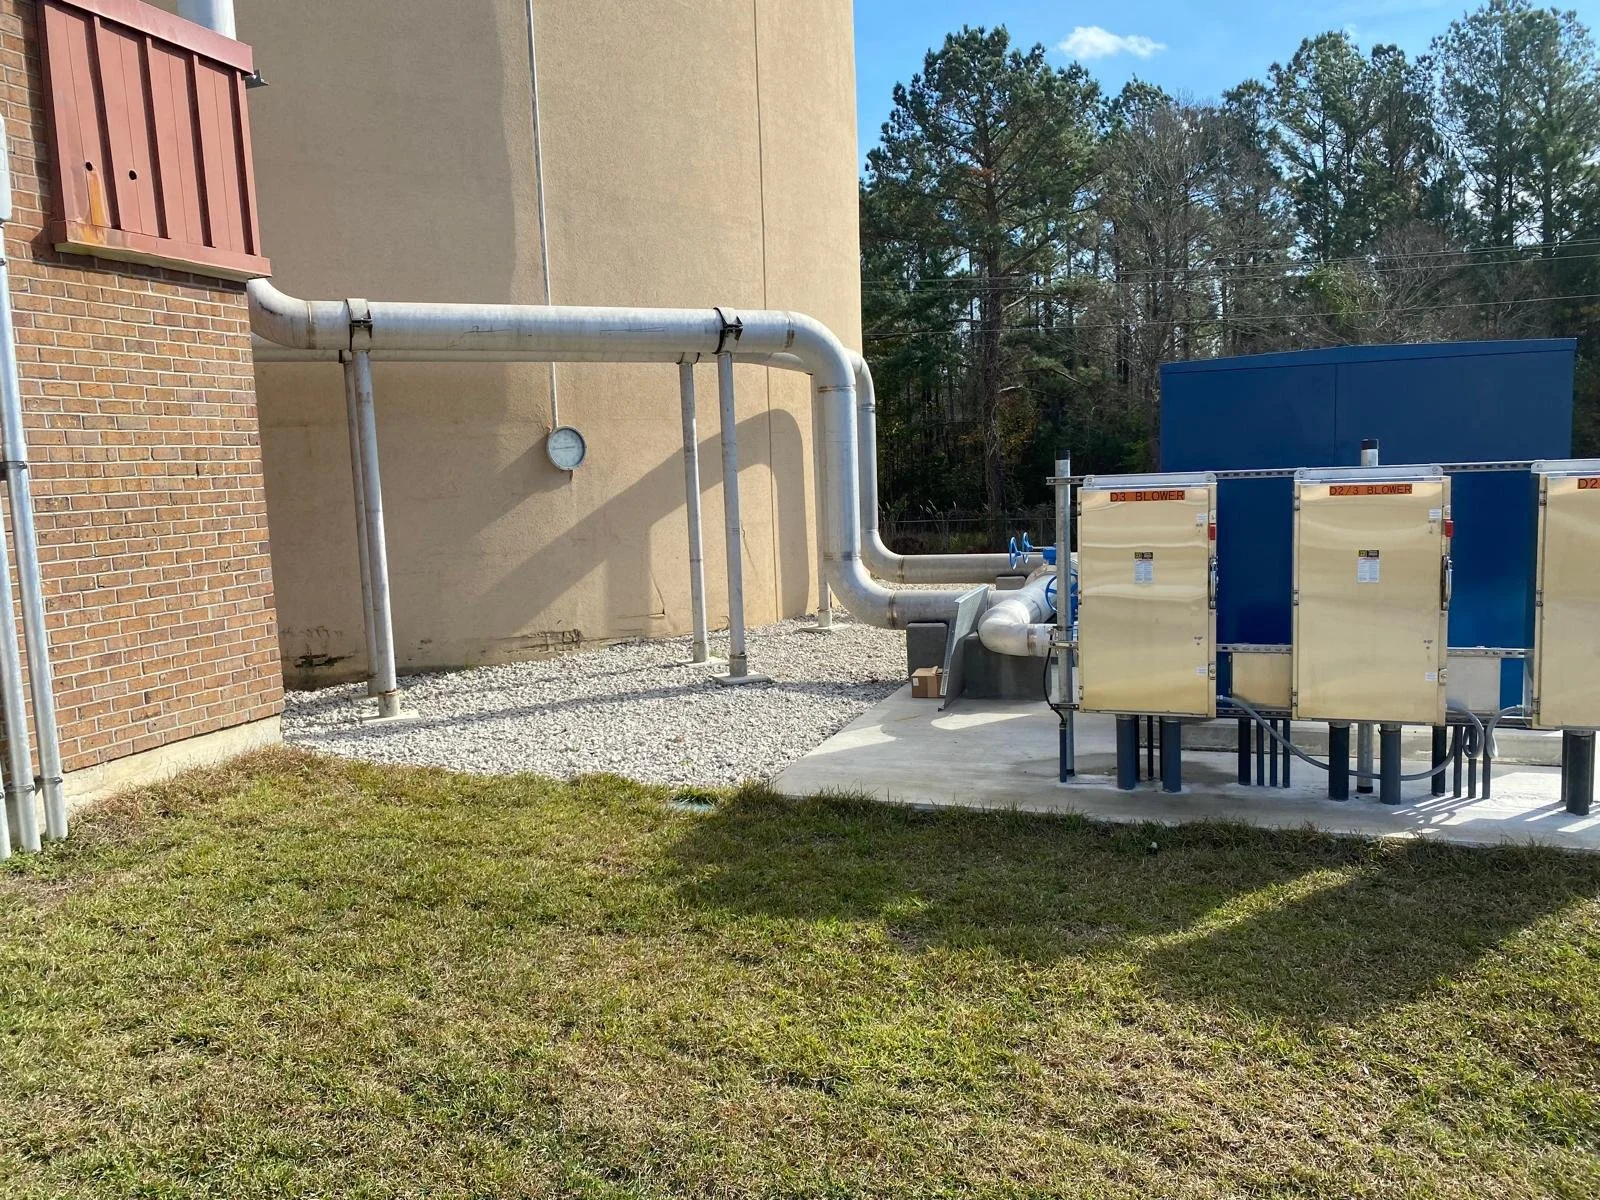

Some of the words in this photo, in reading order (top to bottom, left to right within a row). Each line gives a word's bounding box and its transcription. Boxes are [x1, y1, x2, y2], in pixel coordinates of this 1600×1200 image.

[1110, 492, 1126, 502] D3
[1136, 490, 1185, 501] BLOWER
[1330, 486, 1359, 496] D2/3
[1368, 484, 1412, 495] BLOWER
